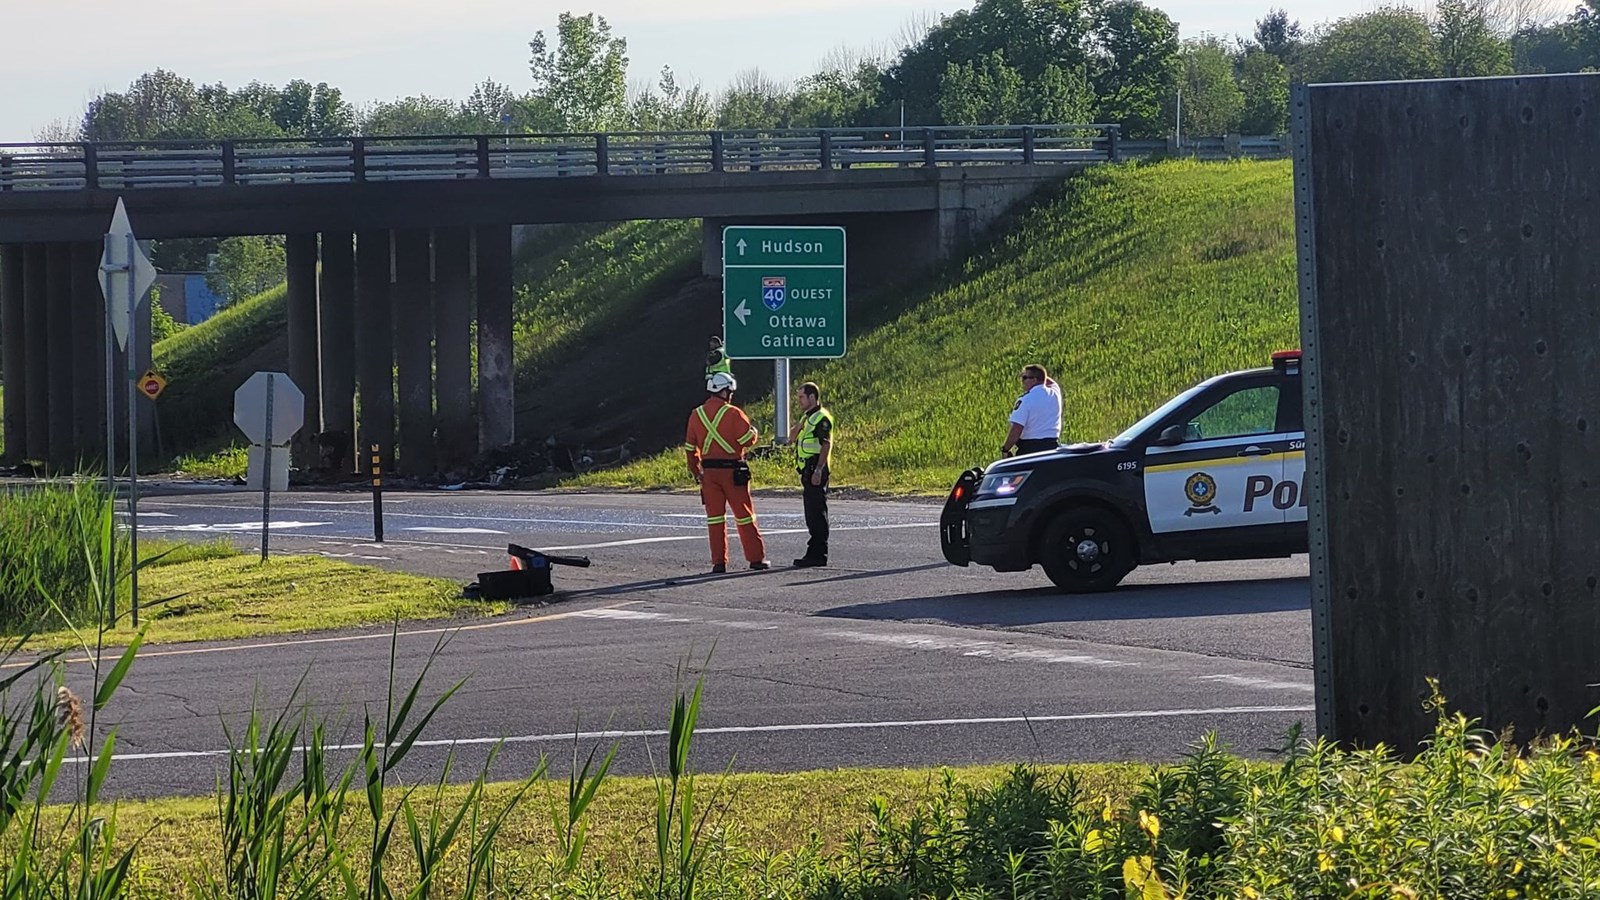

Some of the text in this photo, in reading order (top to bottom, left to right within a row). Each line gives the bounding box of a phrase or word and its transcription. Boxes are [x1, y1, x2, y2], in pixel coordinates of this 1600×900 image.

[762, 239, 823, 253] Hudson
[764, 288, 833, 302] 40 OUEST
[769, 315, 826, 328] Ottawa
[761, 333, 835, 347] Gatineau
[1117, 461, 1137, 471] 6195
